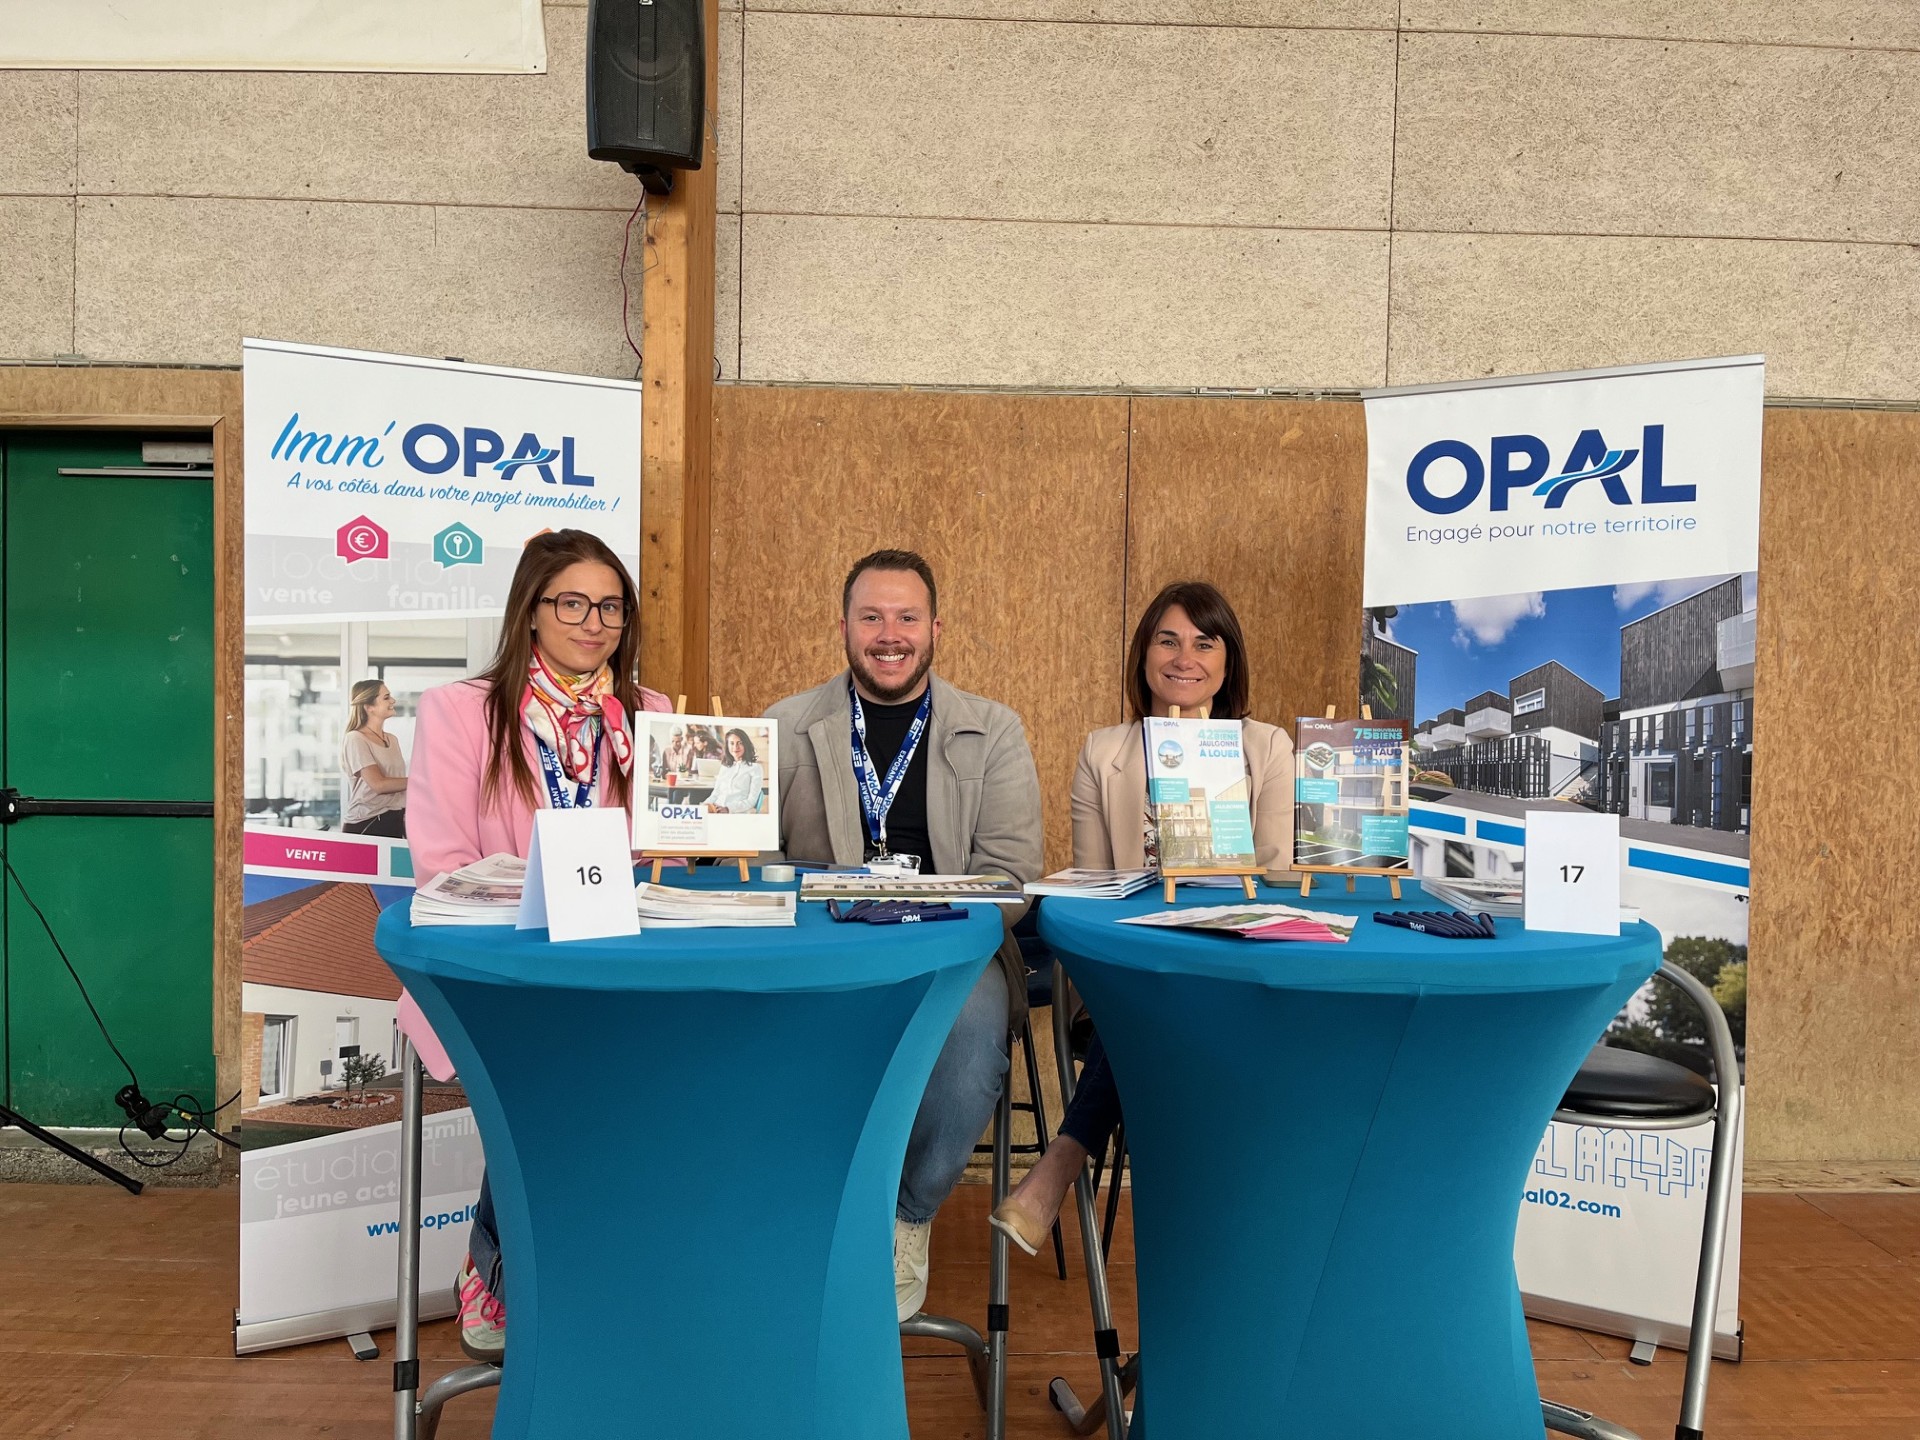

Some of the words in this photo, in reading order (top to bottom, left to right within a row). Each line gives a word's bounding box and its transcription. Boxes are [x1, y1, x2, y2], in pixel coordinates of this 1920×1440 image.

[401, 422, 595, 487] OPAL
[1406, 423, 1697, 515] OPAL
[305, 478, 333, 491] vos
[338, 478, 380, 494] côtés
[384, 480, 425, 498] dans
[429, 484, 470, 501] votre
[471, 490, 522, 512] projet
[524, 492, 607, 511] immobilier
[1406, 523, 1482, 544] Engagé
[1488, 523, 1534, 542] pour
[1542, 519, 1597, 537] notre
[1604, 513, 1697, 534] territoire
[258, 586, 334, 605] vente
[386, 583, 497, 610] famille
[1353, 728, 1373, 740] 75
[1373, 732, 1403, 740] BIENS
[885, 750, 907, 784] EXPOSANT
[1208, 749, 1240, 758] LOUER
[661, 806, 703, 820] OPAL
[859, 781, 873, 818] XPOSANT
[285, 848, 326, 862] VENTE
[576, 865, 603, 886] 16
[1559, 865, 1585, 884] 17
[422, 1116, 476, 1141] amill
[254, 1138, 442, 1191] étudiat
[275, 1190, 348, 1219] jeune
[356, 1179, 400, 1203] act
[1521, 1187, 1621, 1218] al02.com
